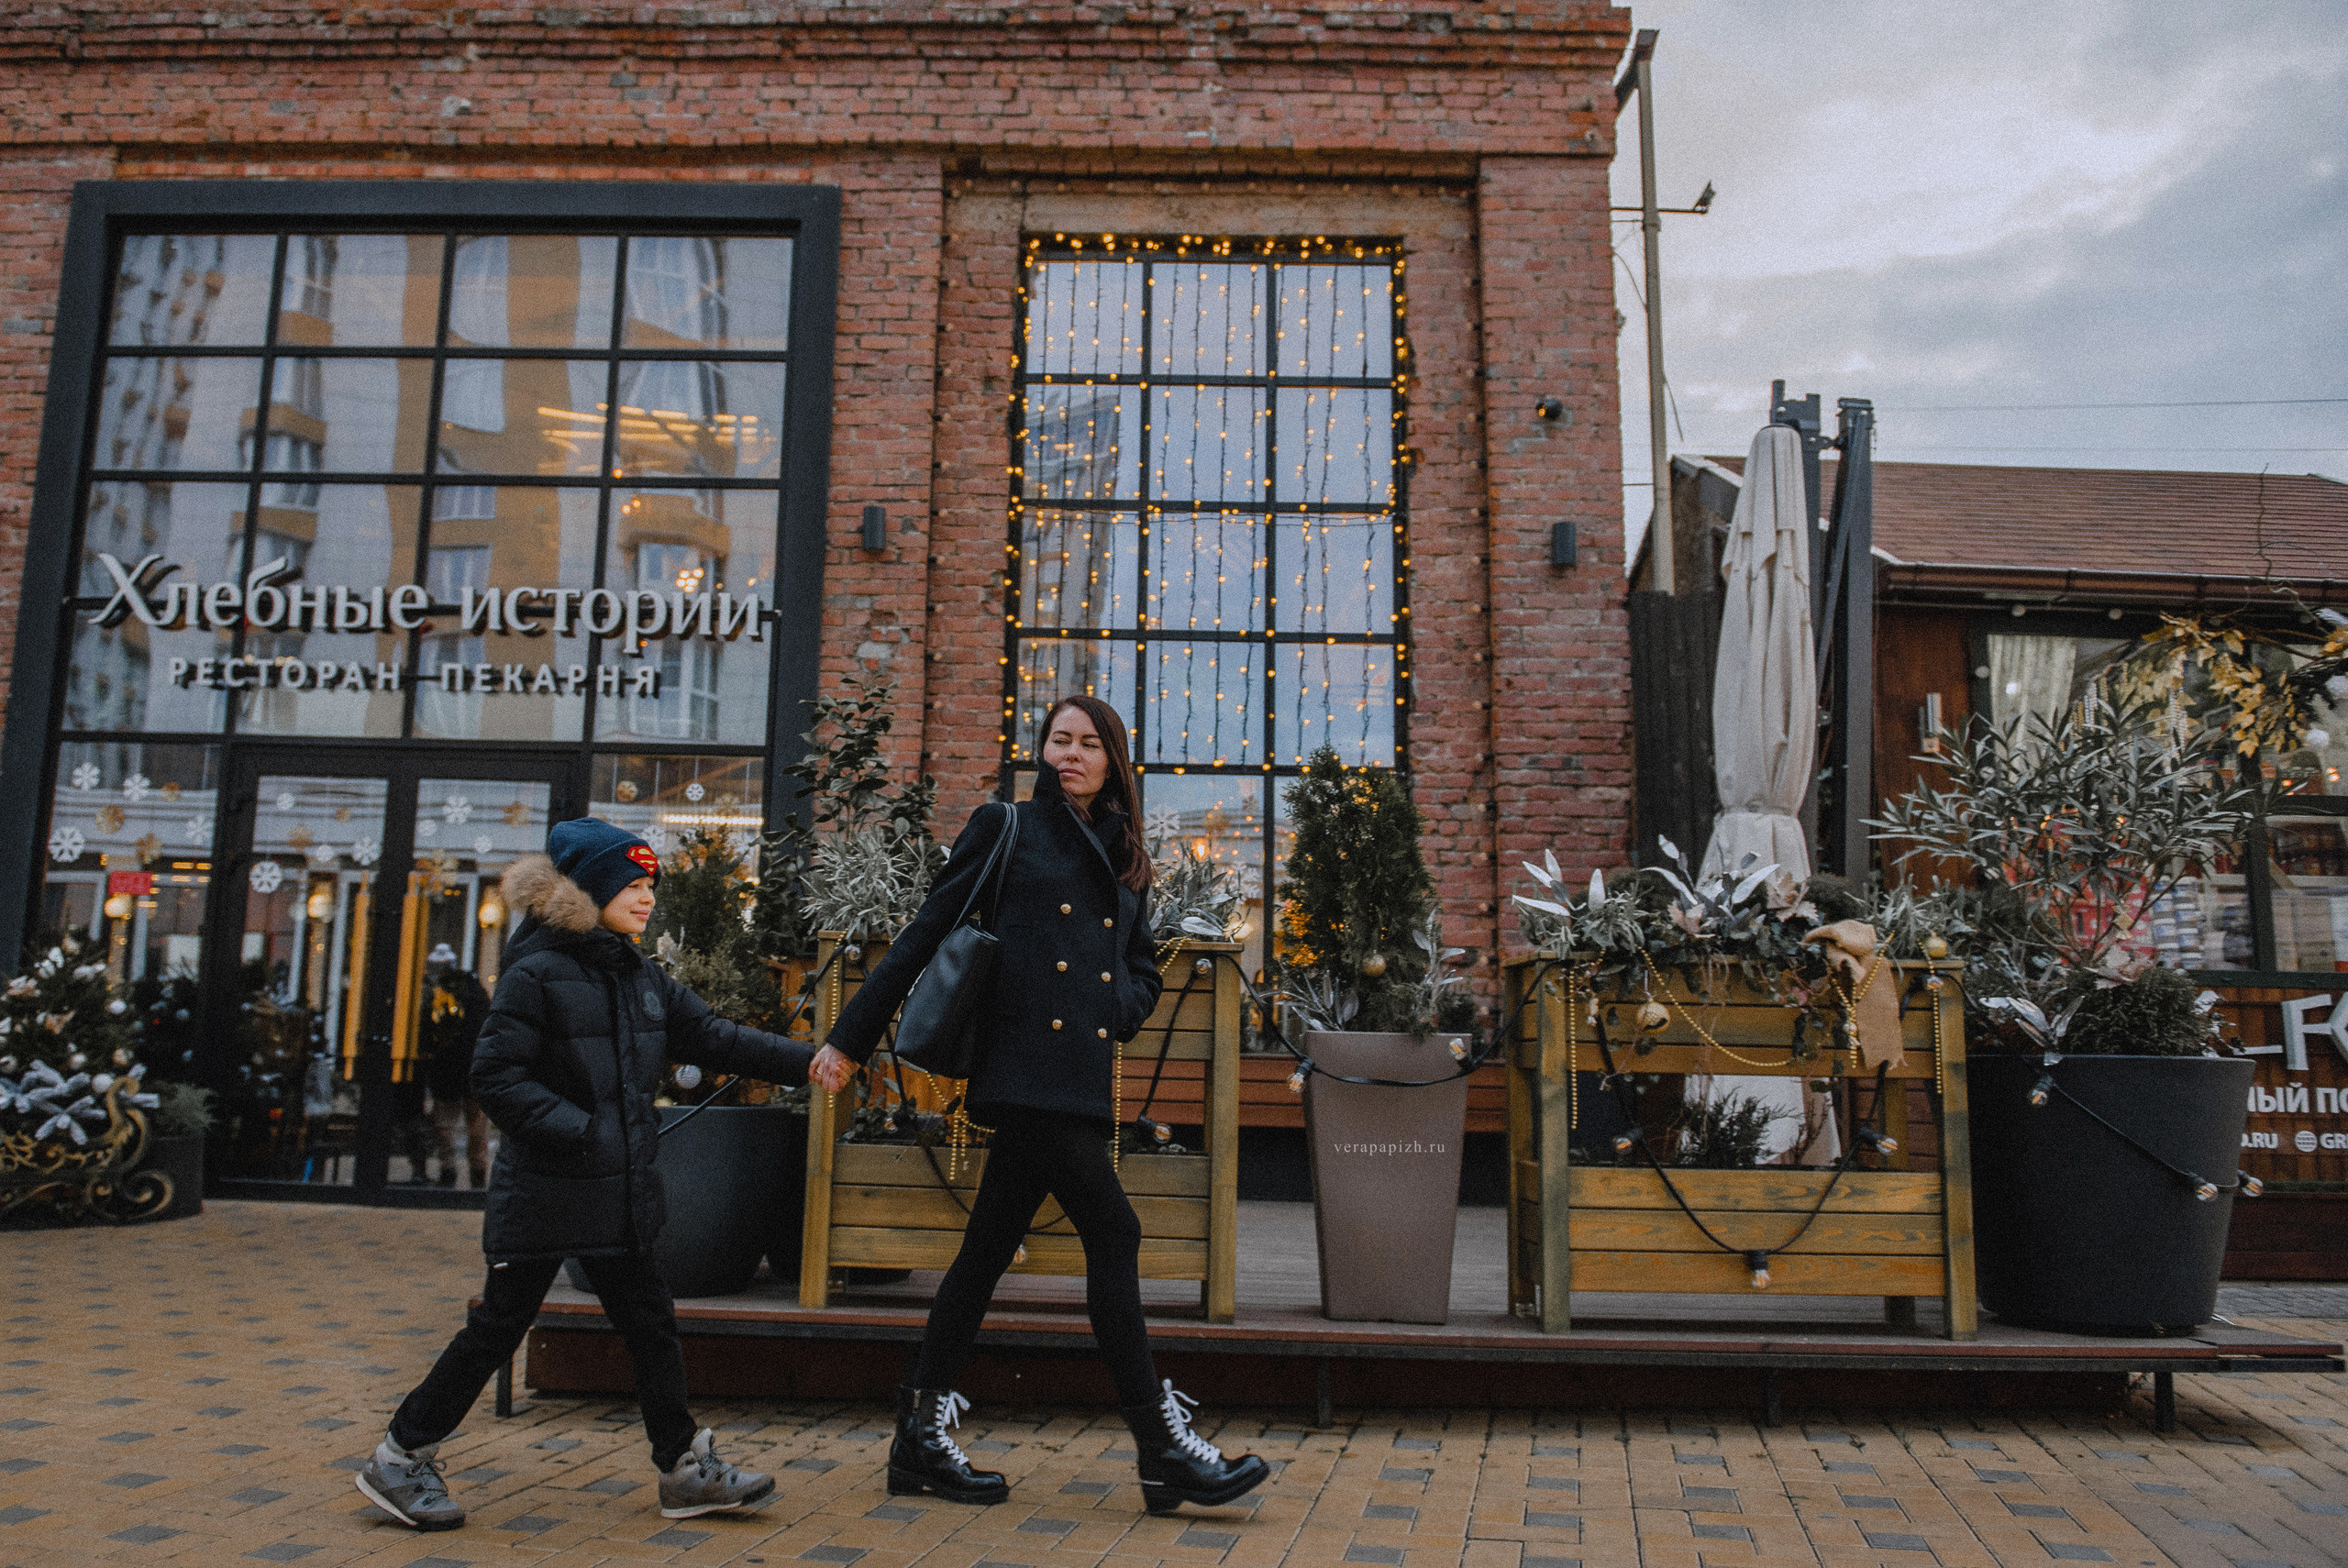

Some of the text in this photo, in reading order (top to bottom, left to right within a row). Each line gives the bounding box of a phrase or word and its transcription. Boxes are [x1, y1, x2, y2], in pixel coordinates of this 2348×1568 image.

[89, 553, 759, 654] Хлебные истории
[169, 657, 656, 694] РЕСТОРАН ПЕКАРНЯ
